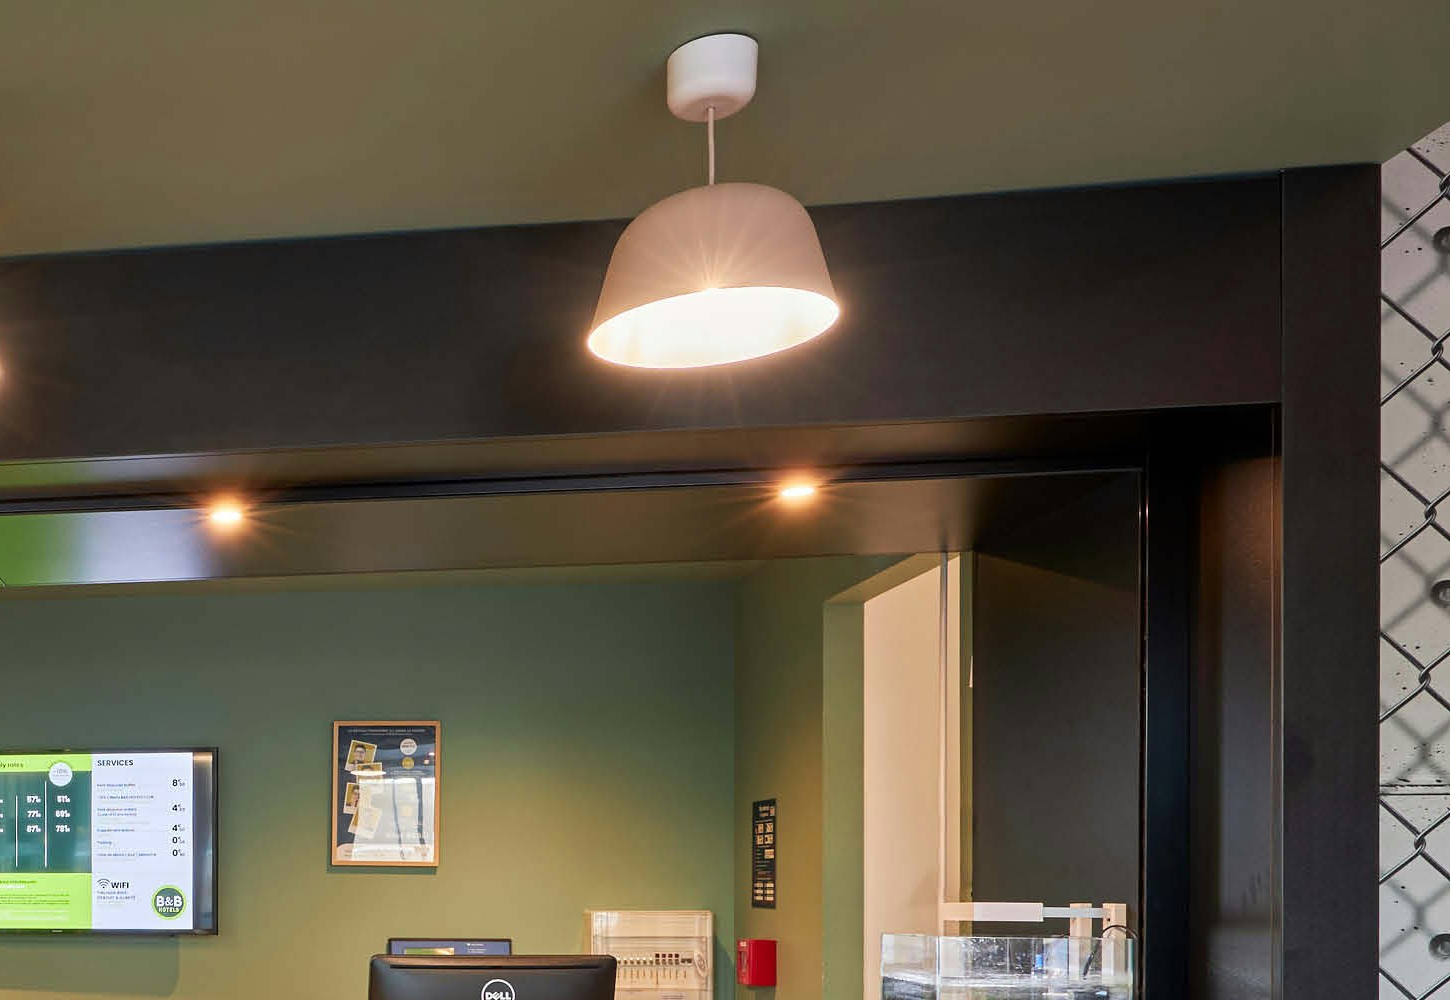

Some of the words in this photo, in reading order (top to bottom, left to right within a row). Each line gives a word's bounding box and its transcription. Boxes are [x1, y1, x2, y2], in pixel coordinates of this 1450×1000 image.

[97, 759, 134, 767] SERVICES
[156, 895, 183, 907] B&B
[485, 991, 512, 1000] DELL
